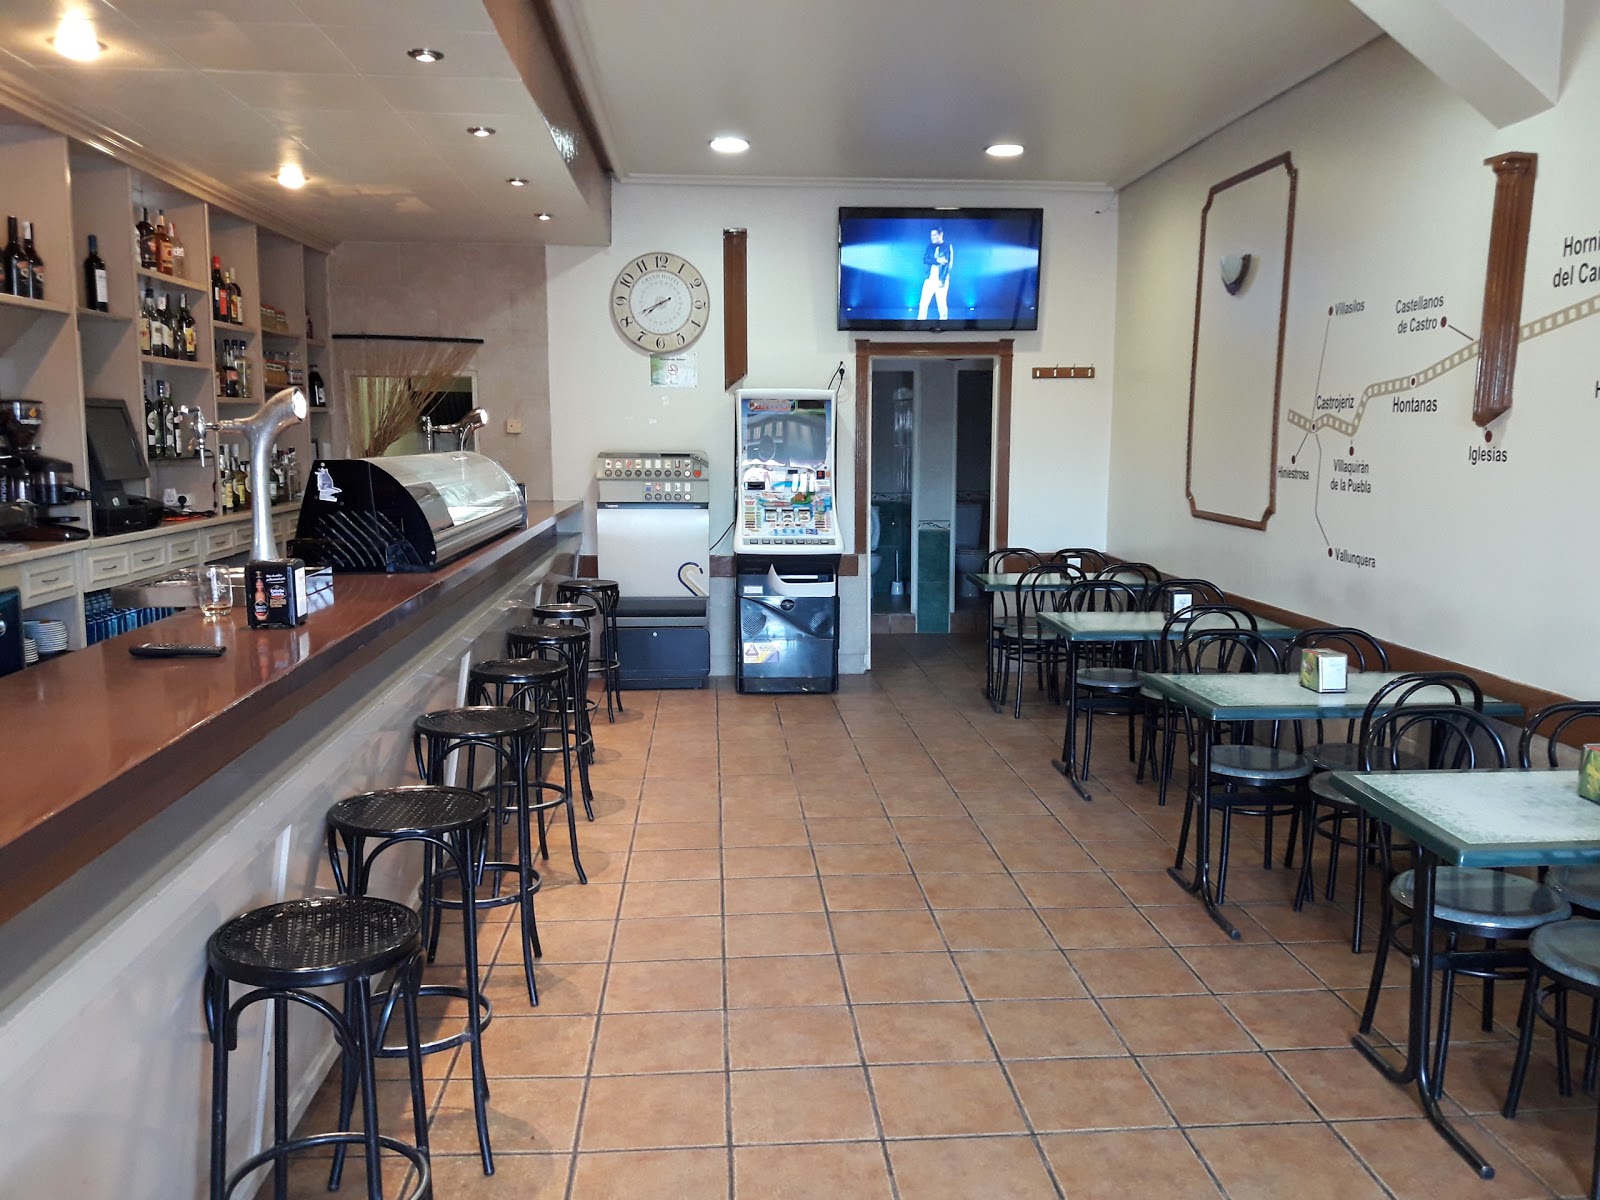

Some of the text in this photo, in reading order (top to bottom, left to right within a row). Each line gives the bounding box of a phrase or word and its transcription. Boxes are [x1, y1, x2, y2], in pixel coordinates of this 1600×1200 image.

[636, 259, 648, 273] 11
[655, 255, 669, 268] 12
[677, 263, 686, 274] 1
[619, 272, 635, 289] 10
[1553, 264, 1574, 288] del
[689, 278, 702, 289] 2
[614, 296, 627, 306] 9
[694, 300, 706, 310] 3
[1335, 300, 1365, 316] Villasilos
[1395, 295, 1444, 314] Castellanos
[620, 316, 633, 328] 8
[1397, 317, 1437, 334] de Castro
[637, 330, 647, 342] 7
[676, 332, 686, 346] 5
[655, 337, 665, 350] 6
[1392, 396, 1437, 412] Hontanas
[1469, 445, 1508, 465] Iglesias
[1330, 478, 1371, 493] de la Puebla
[1335, 548, 1376, 568] Vallunquera
